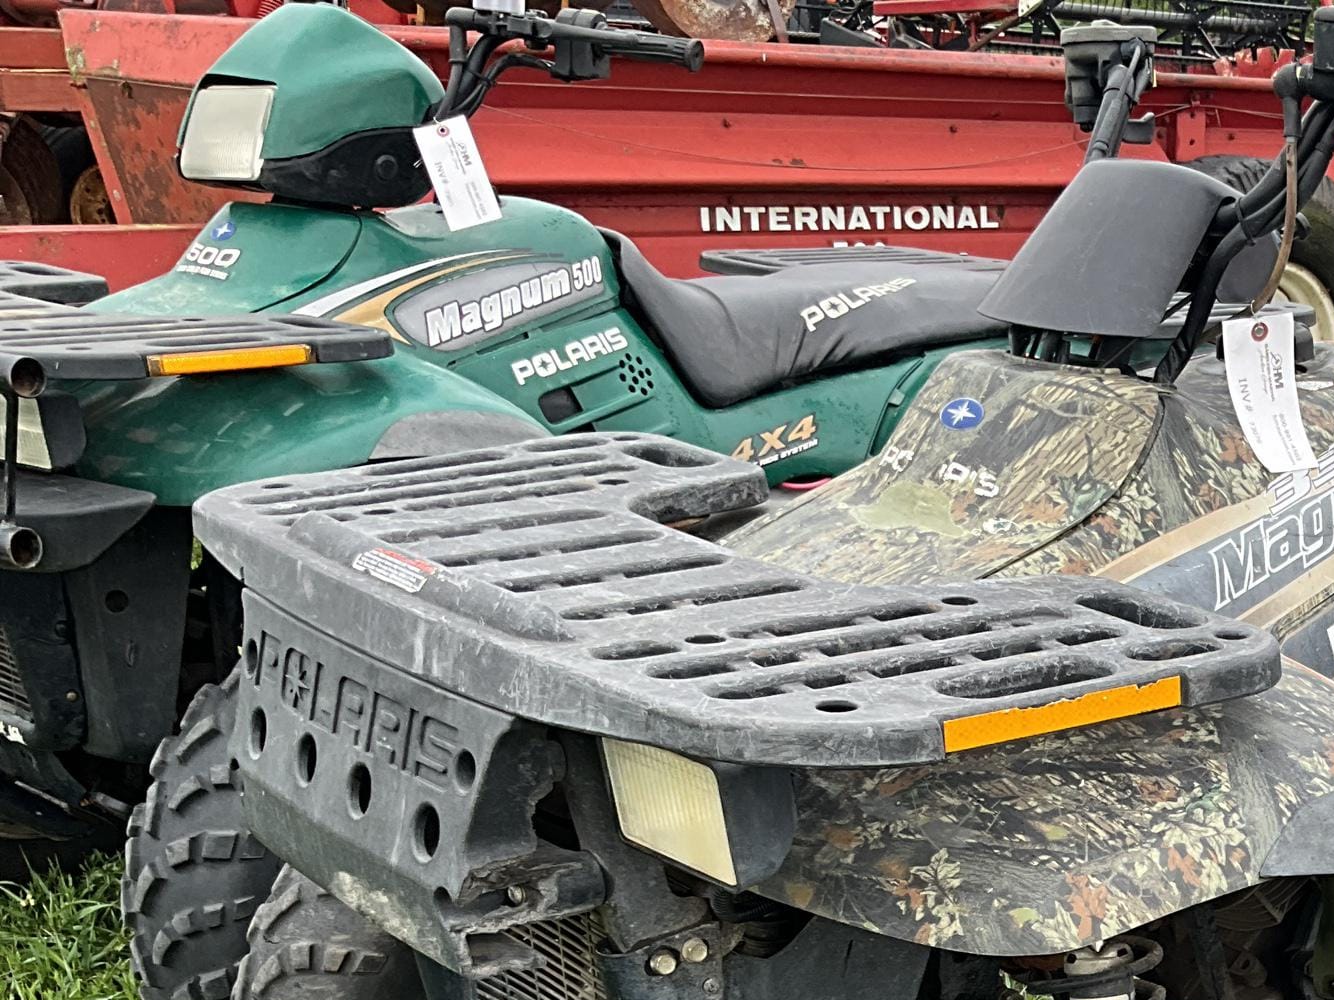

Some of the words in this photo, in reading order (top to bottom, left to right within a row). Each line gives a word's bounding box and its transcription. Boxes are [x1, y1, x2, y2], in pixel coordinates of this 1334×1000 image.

[700, 206, 999, 232] INTERNATIONAL
[186, 242, 241, 268] 500
[424, 267, 572, 347] Magnum
[571, 256, 603, 291] 500
[800, 277, 917, 332] POLARIS
[511, 326, 629, 385] POLARIS
[1238, 378, 1251, 404] INV
[255, 630, 460, 793] POLARIS
